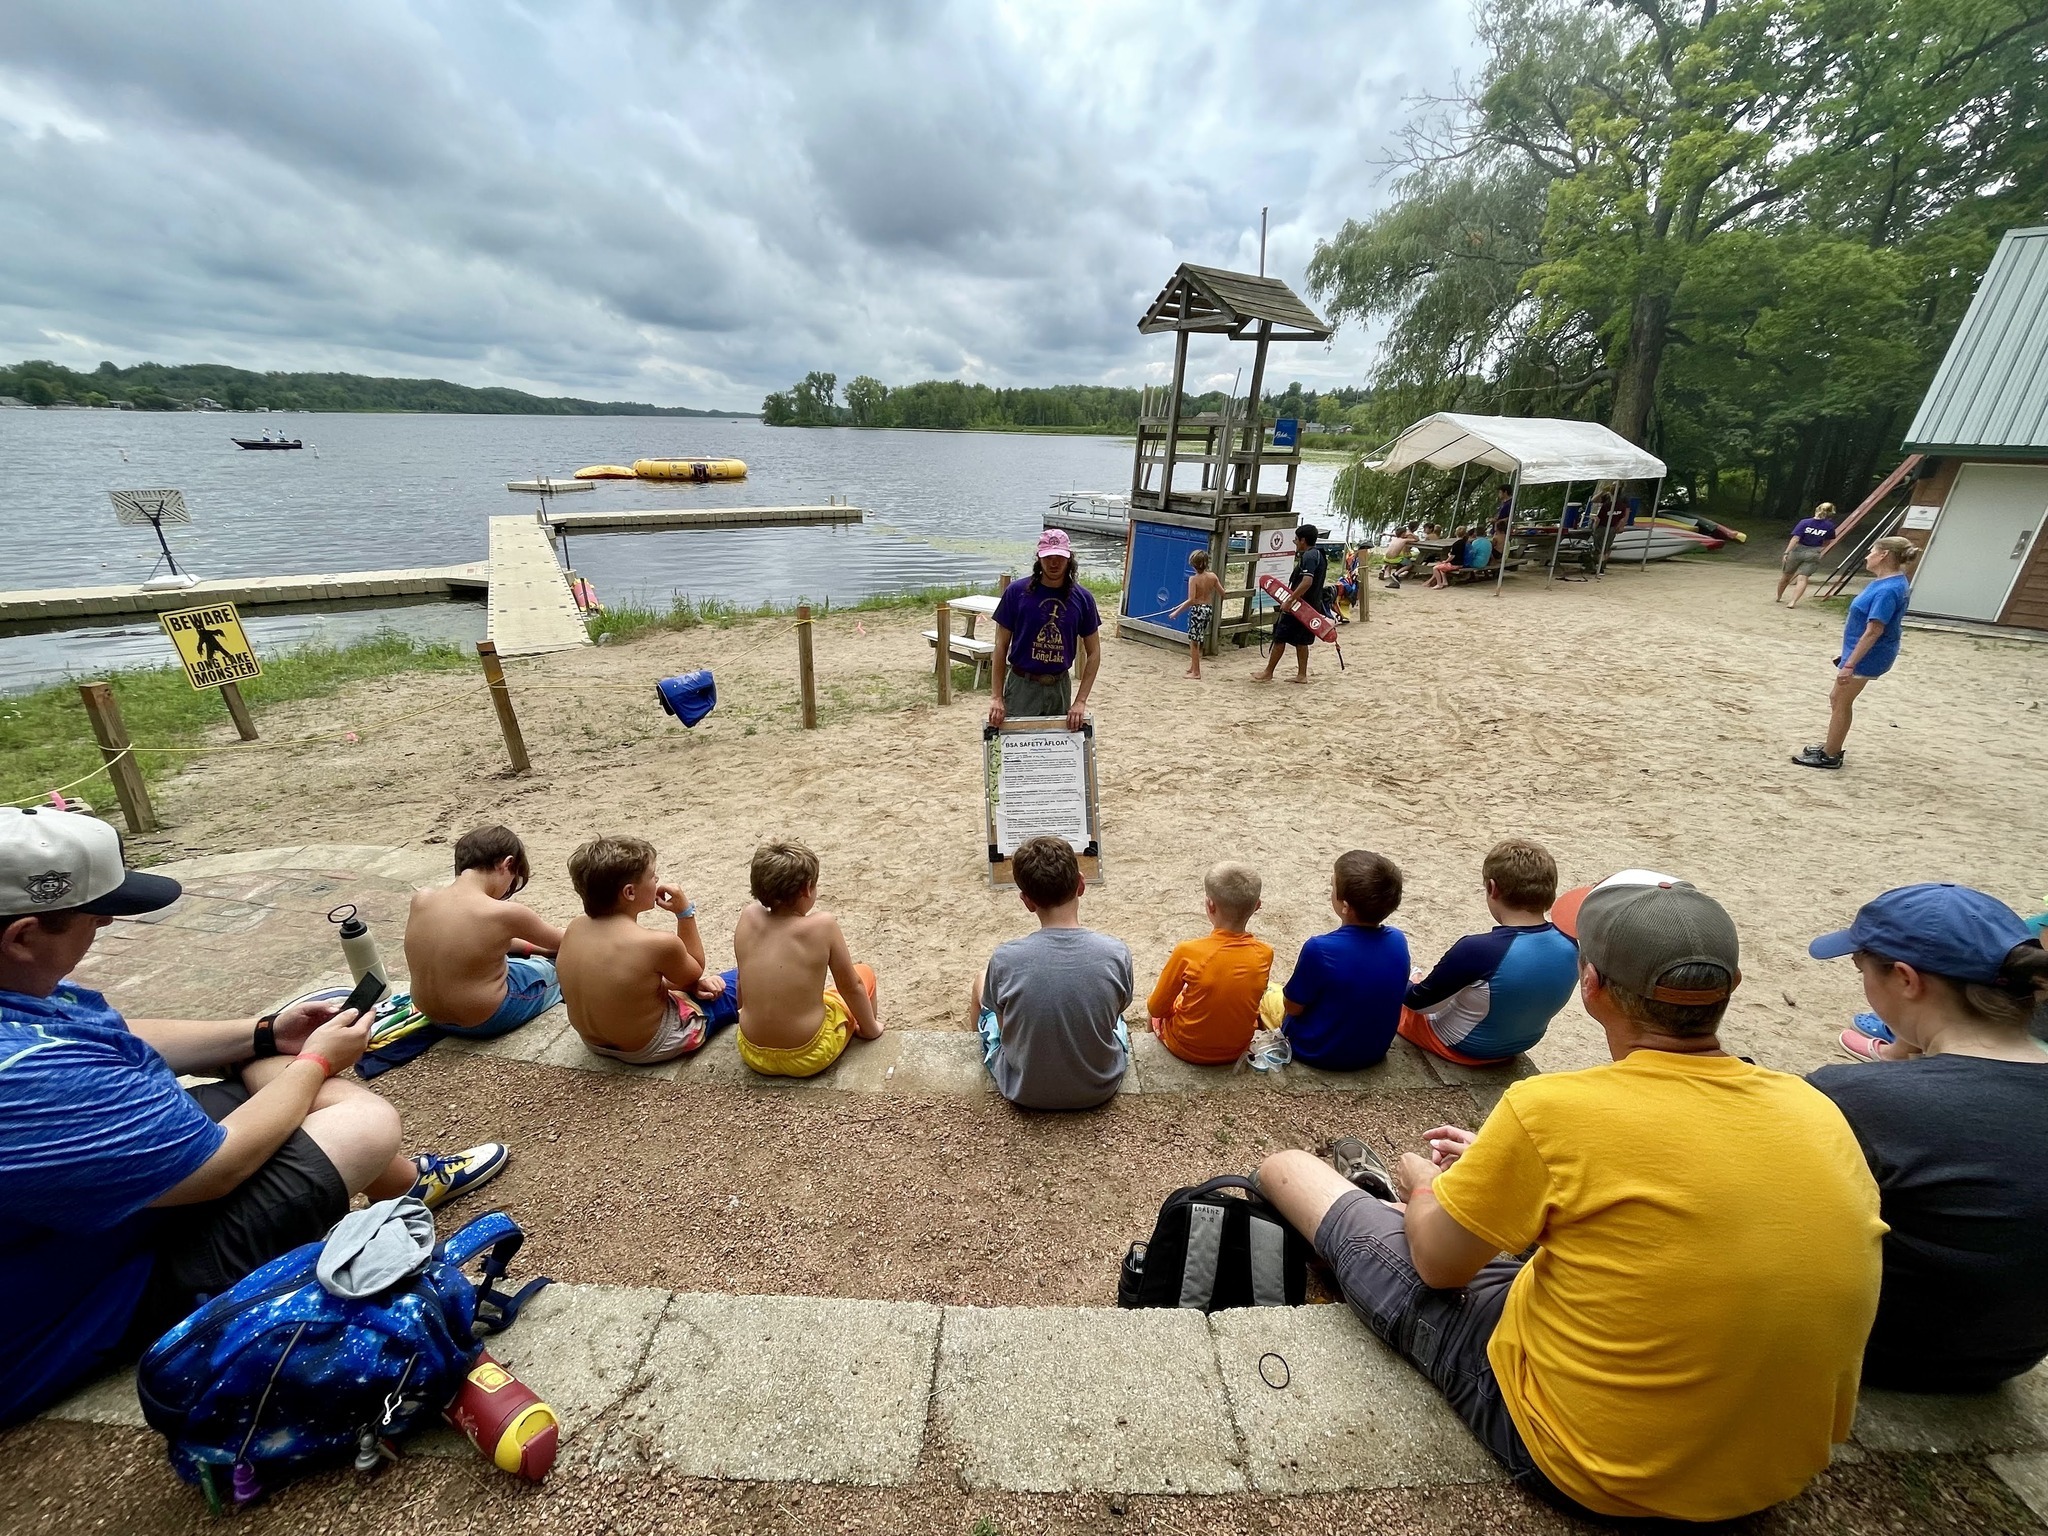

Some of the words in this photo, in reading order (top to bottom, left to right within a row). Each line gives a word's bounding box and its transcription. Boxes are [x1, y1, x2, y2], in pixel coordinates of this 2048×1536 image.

[1804, 527, 1827, 536] STAFF
[1275, 587, 1302, 612] GUD
[169, 608, 233, 632] BEWARE
[190, 659, 220, 673] LONG
[222, 652, 251, 665] LAKE
[1032, 648, 1049, 664] Long
[1049, 651, 1065, 663] Lake
[194, 662, 255, 685] MONSTER
